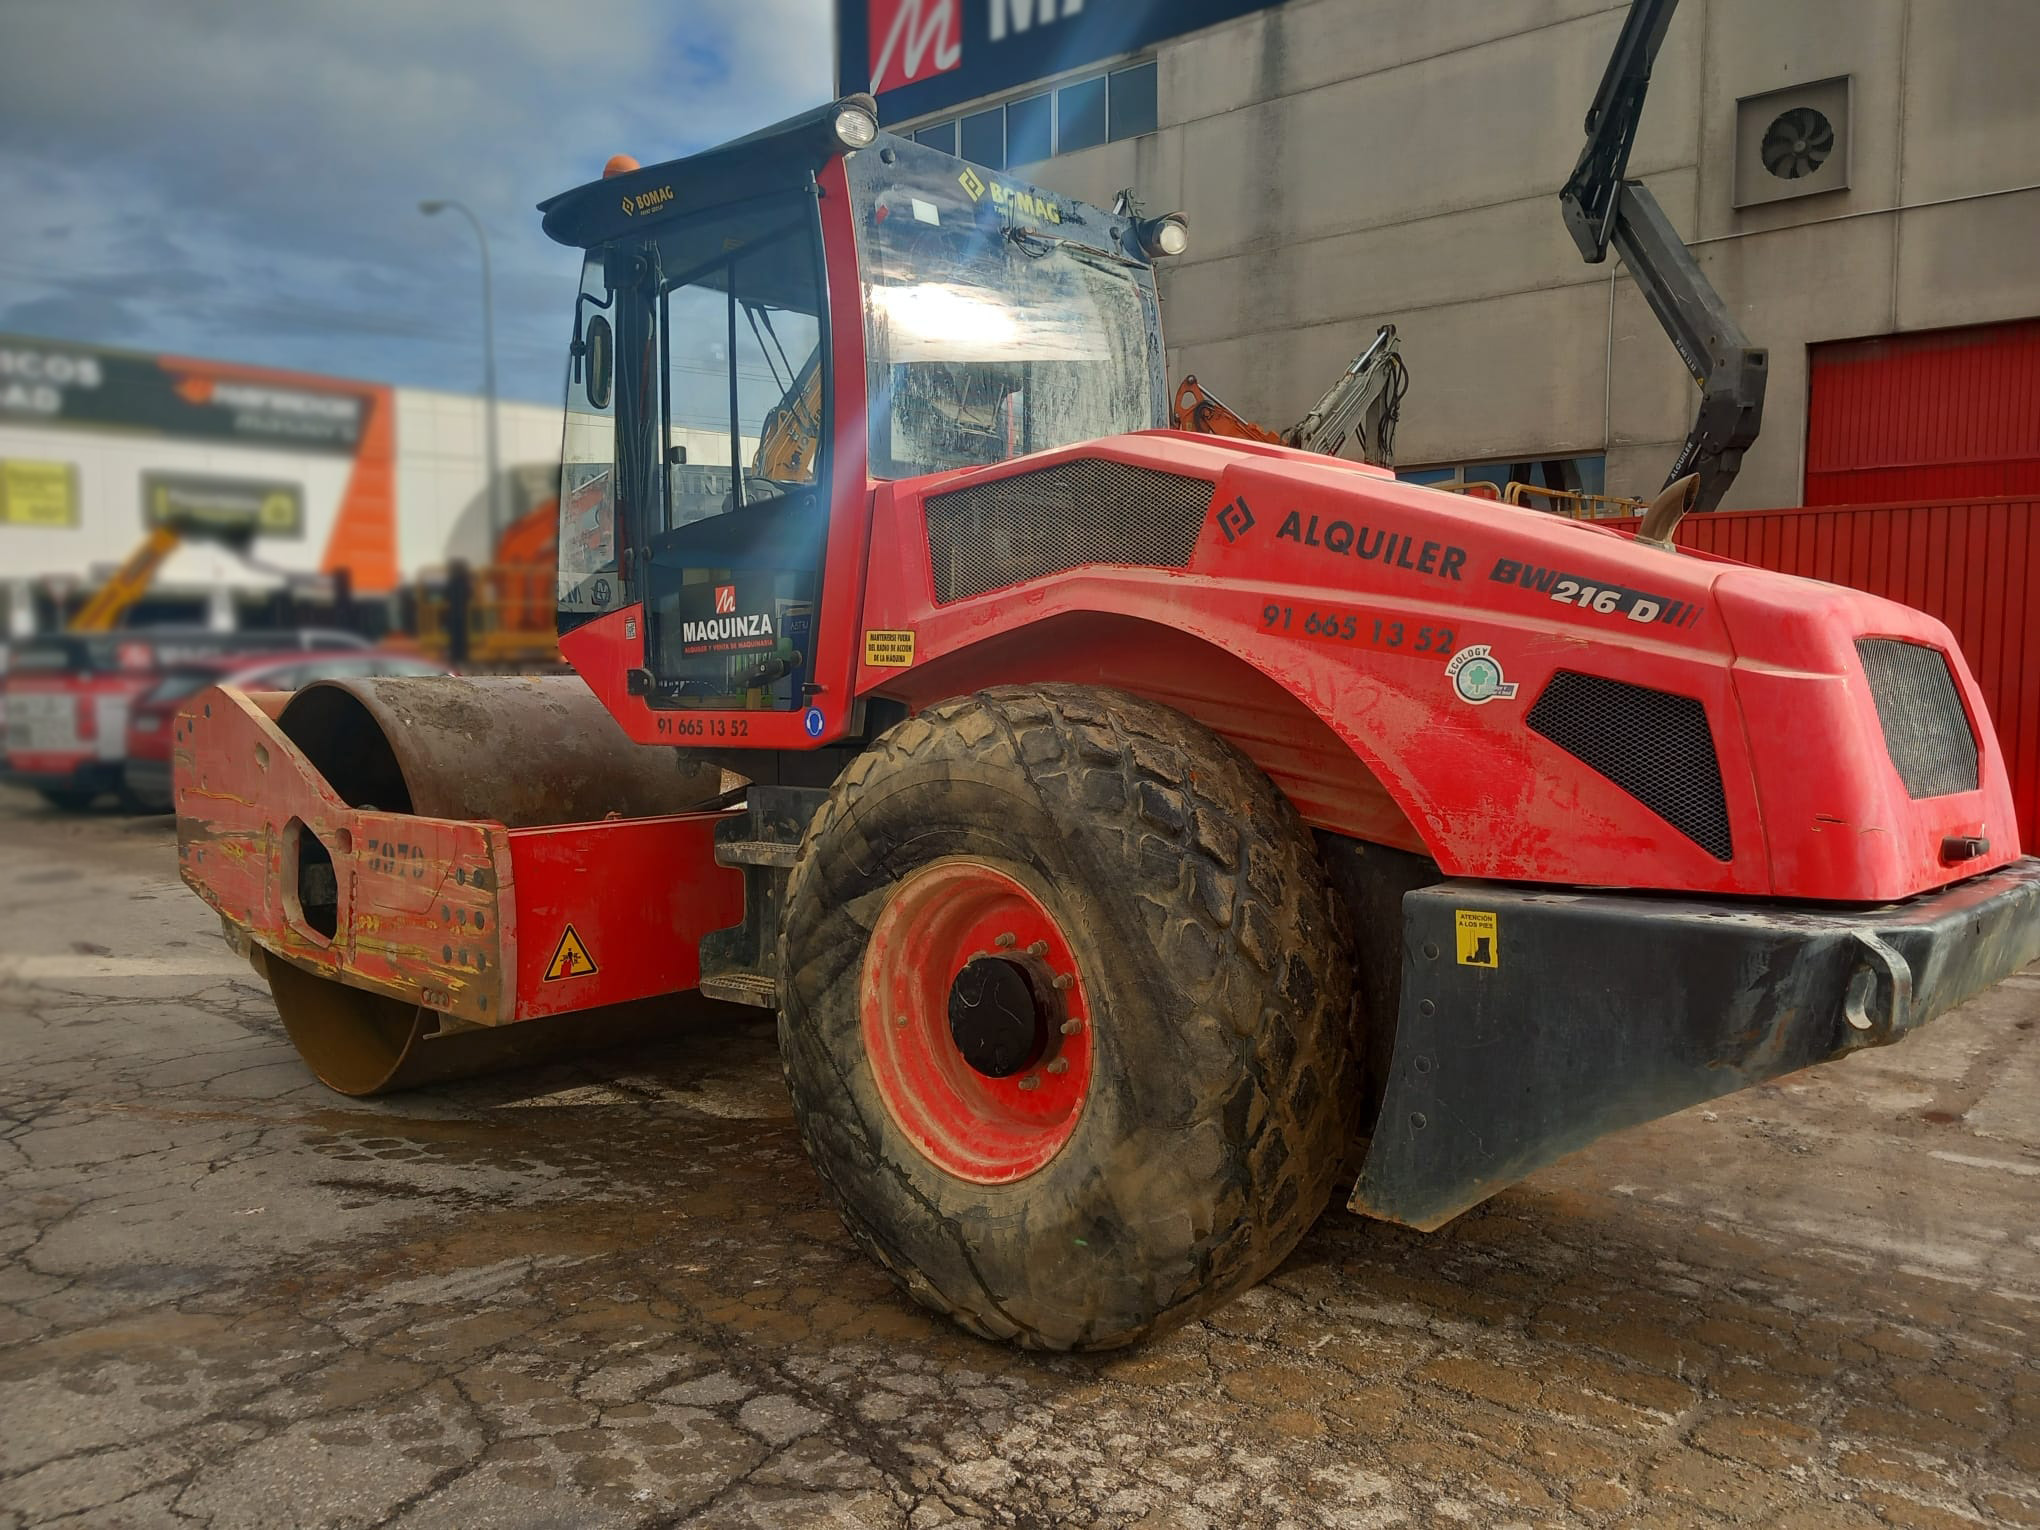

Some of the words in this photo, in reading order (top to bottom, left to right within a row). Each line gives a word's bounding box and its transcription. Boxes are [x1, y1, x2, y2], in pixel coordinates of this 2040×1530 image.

[636, 185, 674, 209] BOMAG
[989, 181, 1060, 224] BOMAG
[1671, 441, 1693, 480] ALQUILER
[1276, 511, 1467, 581] ALQUILER
[1627, 599, 1660, 623] D
[683, 613, 773, 643] MAQUINZA
[1263, 604, 1293, 630] 91
[1304, 612, 1357, 641] 665
[1372, 619, 1405, 647] 13
[1414, 626, 1455, 655] 52
[1448, 647, 1488, 675] ECOLOGY
[657, 718, 673, 735] 91
[678, 719, 704, 736] 665
[709, 719, 726, 737] 13
[731, 719, 749, 737] 52
